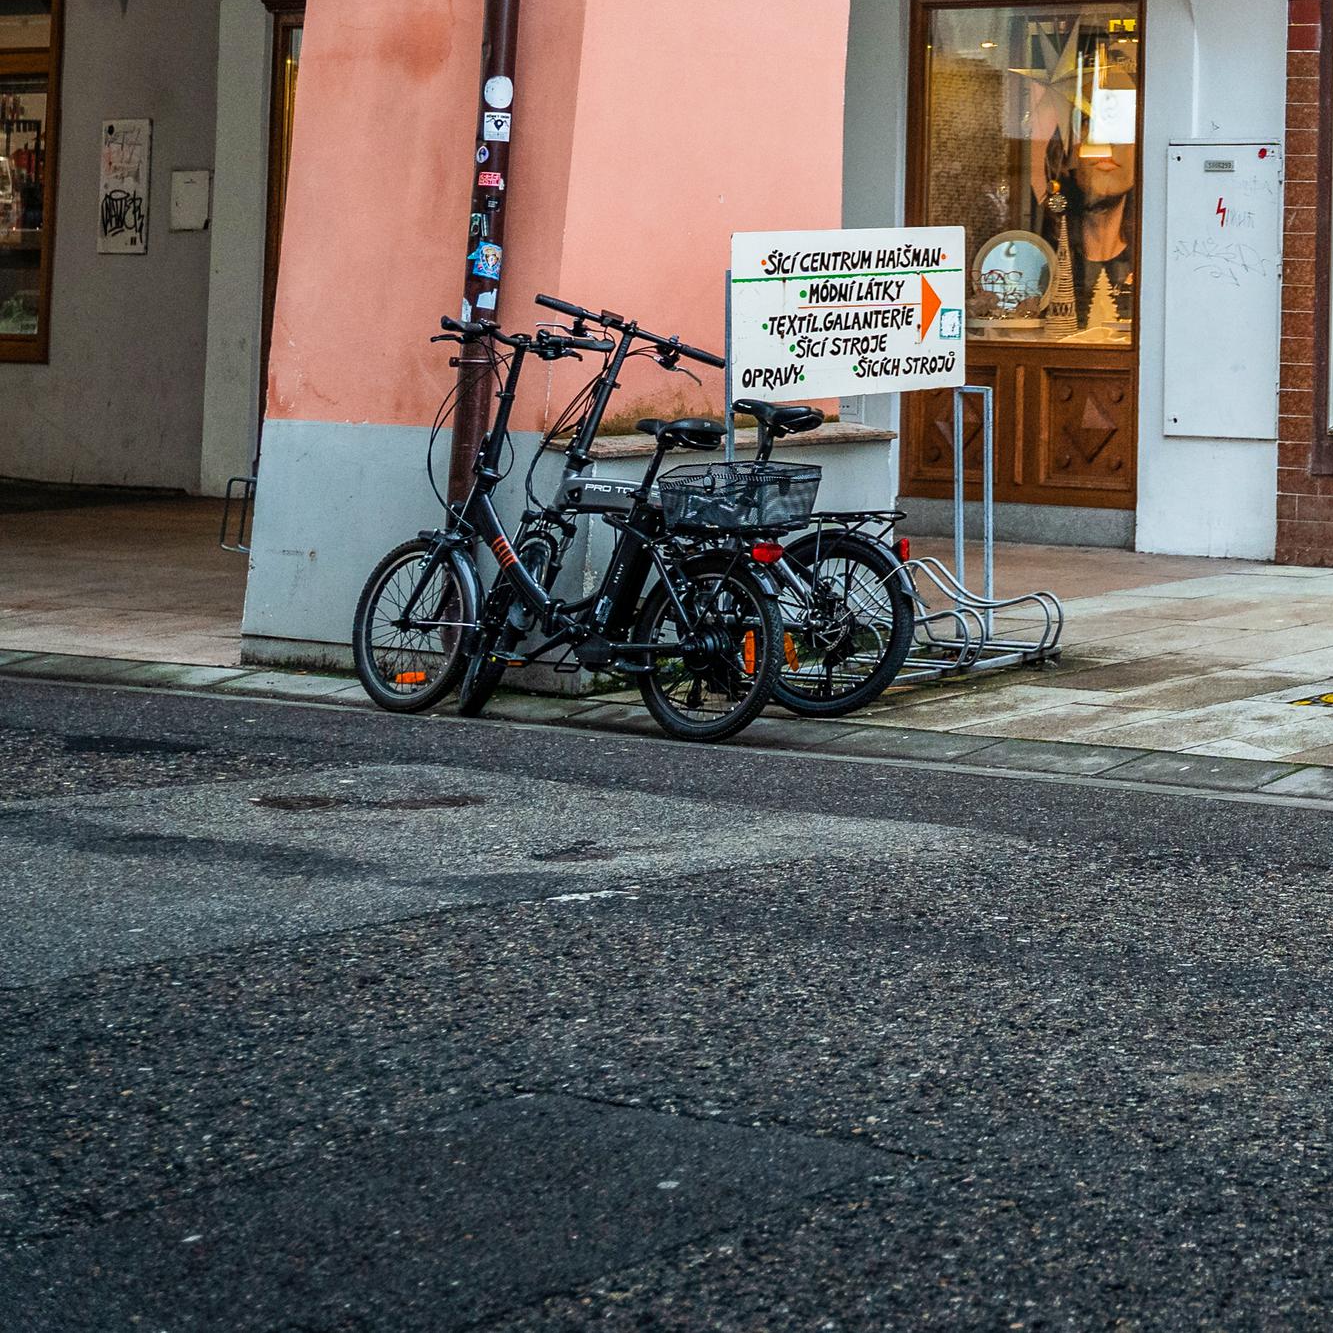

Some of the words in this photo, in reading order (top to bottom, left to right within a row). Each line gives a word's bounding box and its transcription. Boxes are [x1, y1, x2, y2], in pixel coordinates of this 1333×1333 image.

[800, 249, 872, 273] CENTRUM
[808, 279, 855, 304] MÓDNÍ
[856, 278, 906, 303] LÁTKY
[829, 333, 888, 357] STROJE
[741, 364, 804, 390] OPRAVY
[902, 351, 956, 375] STROJŮ
[585, 483, 612, 493] PRO
